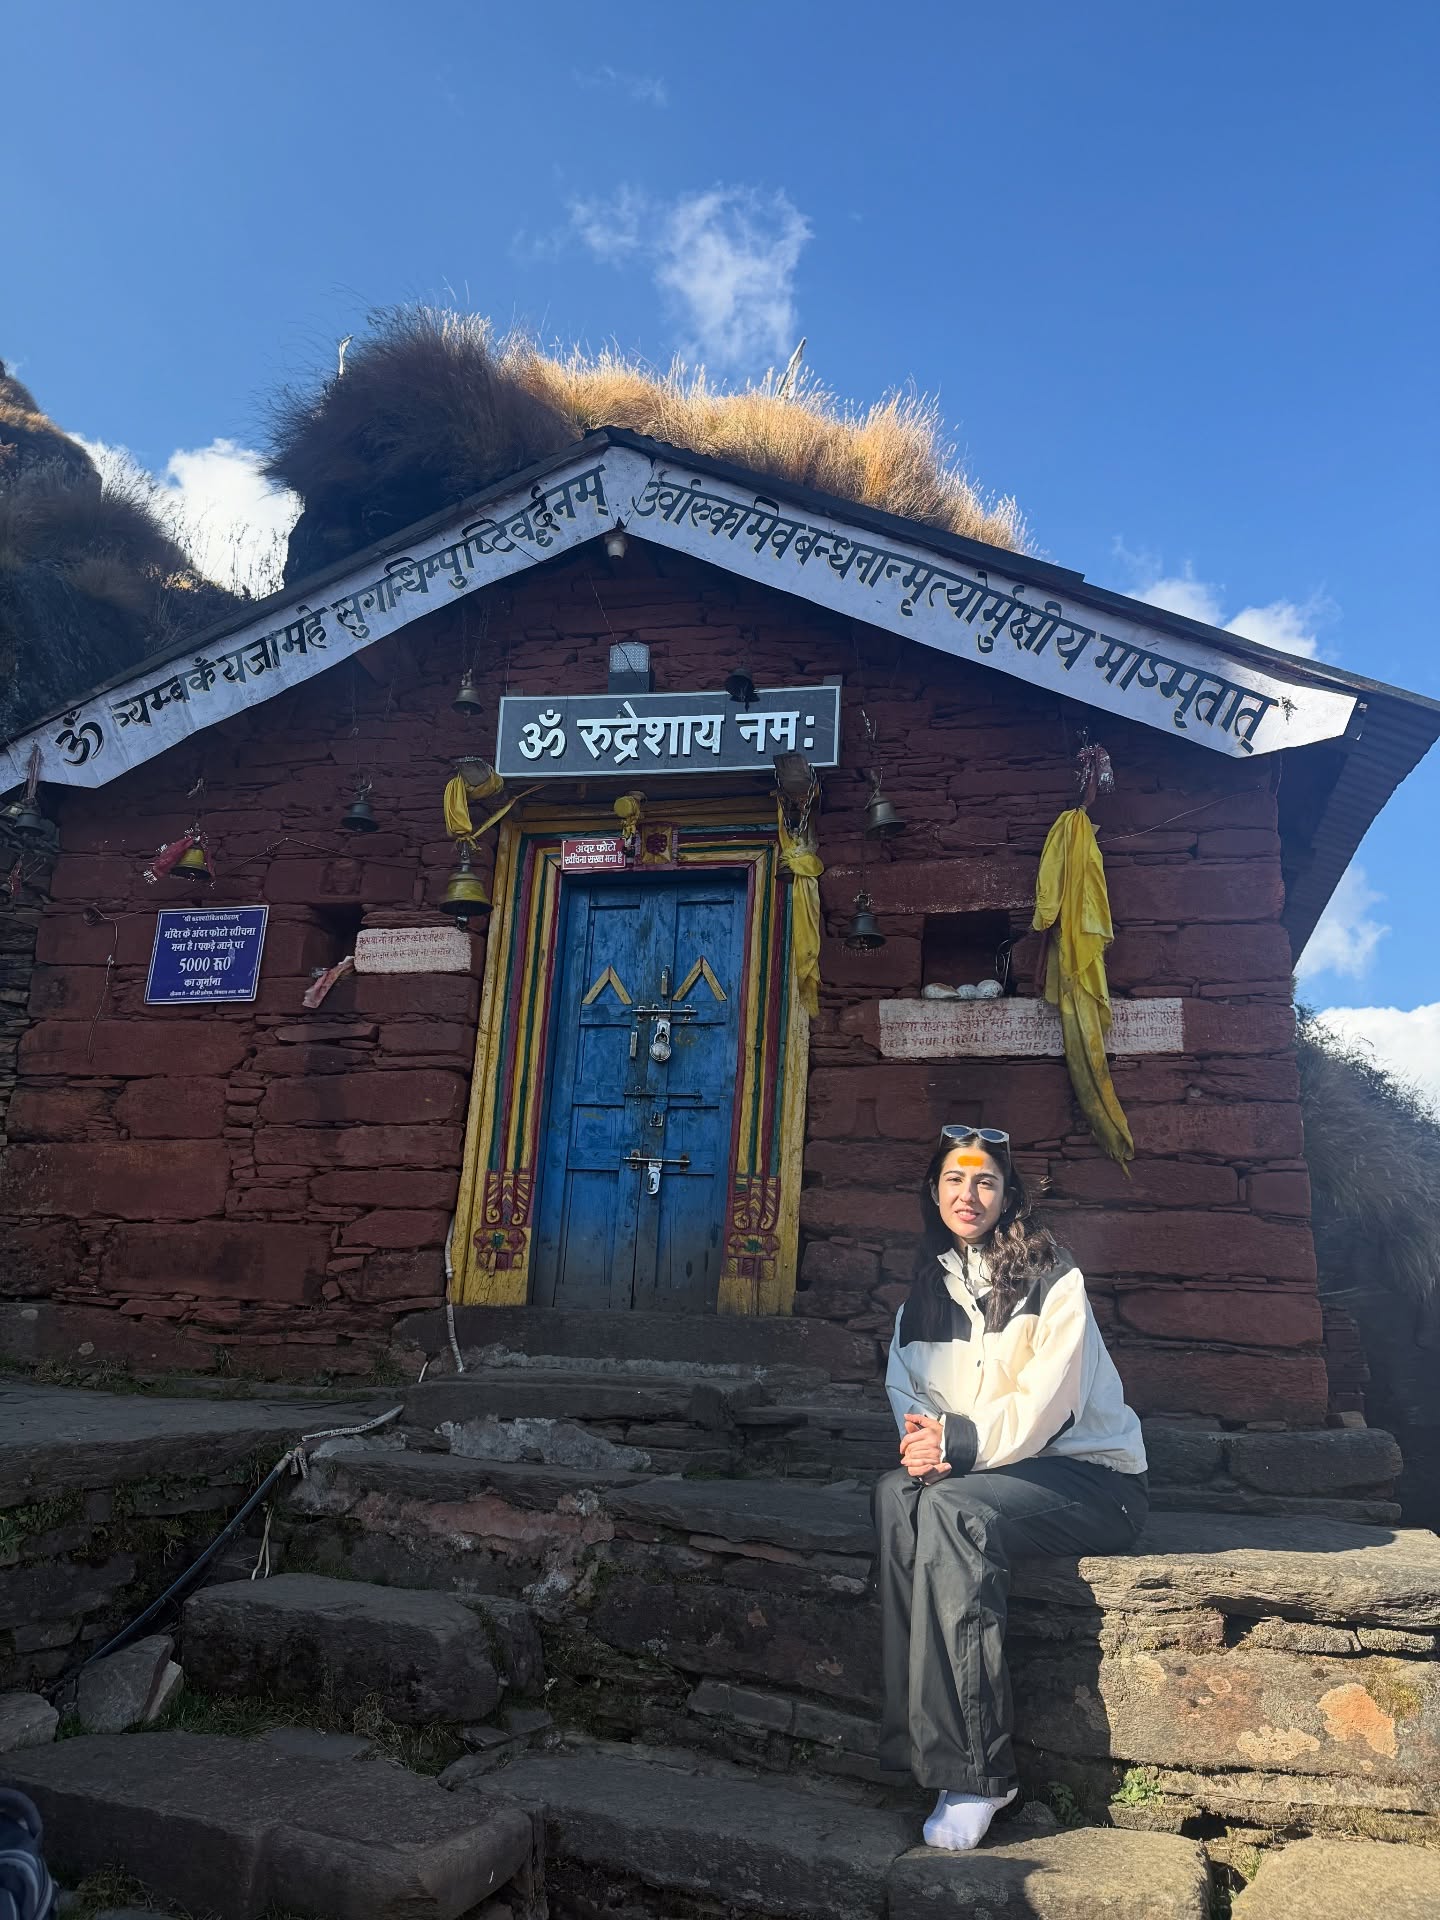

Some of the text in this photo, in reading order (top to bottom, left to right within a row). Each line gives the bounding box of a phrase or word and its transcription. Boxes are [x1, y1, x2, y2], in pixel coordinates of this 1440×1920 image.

[576, 700, 725, 764] रुद्रेशाय
[596, 841, 616, 852] फोटो
[164, 927, 182, 939] मंदिर
[182, 927, 191, 938] के
[192, 926, 208, 938] अंदर
[209, 926, 228, 937] फोटो
[171, 942, 186, 952] मना
[216, 939, 233, 950] जाने
[234, 941, 246, 949] पर
[178, 957, 211, 974] 5000
[184, 978, 195, 987] का
